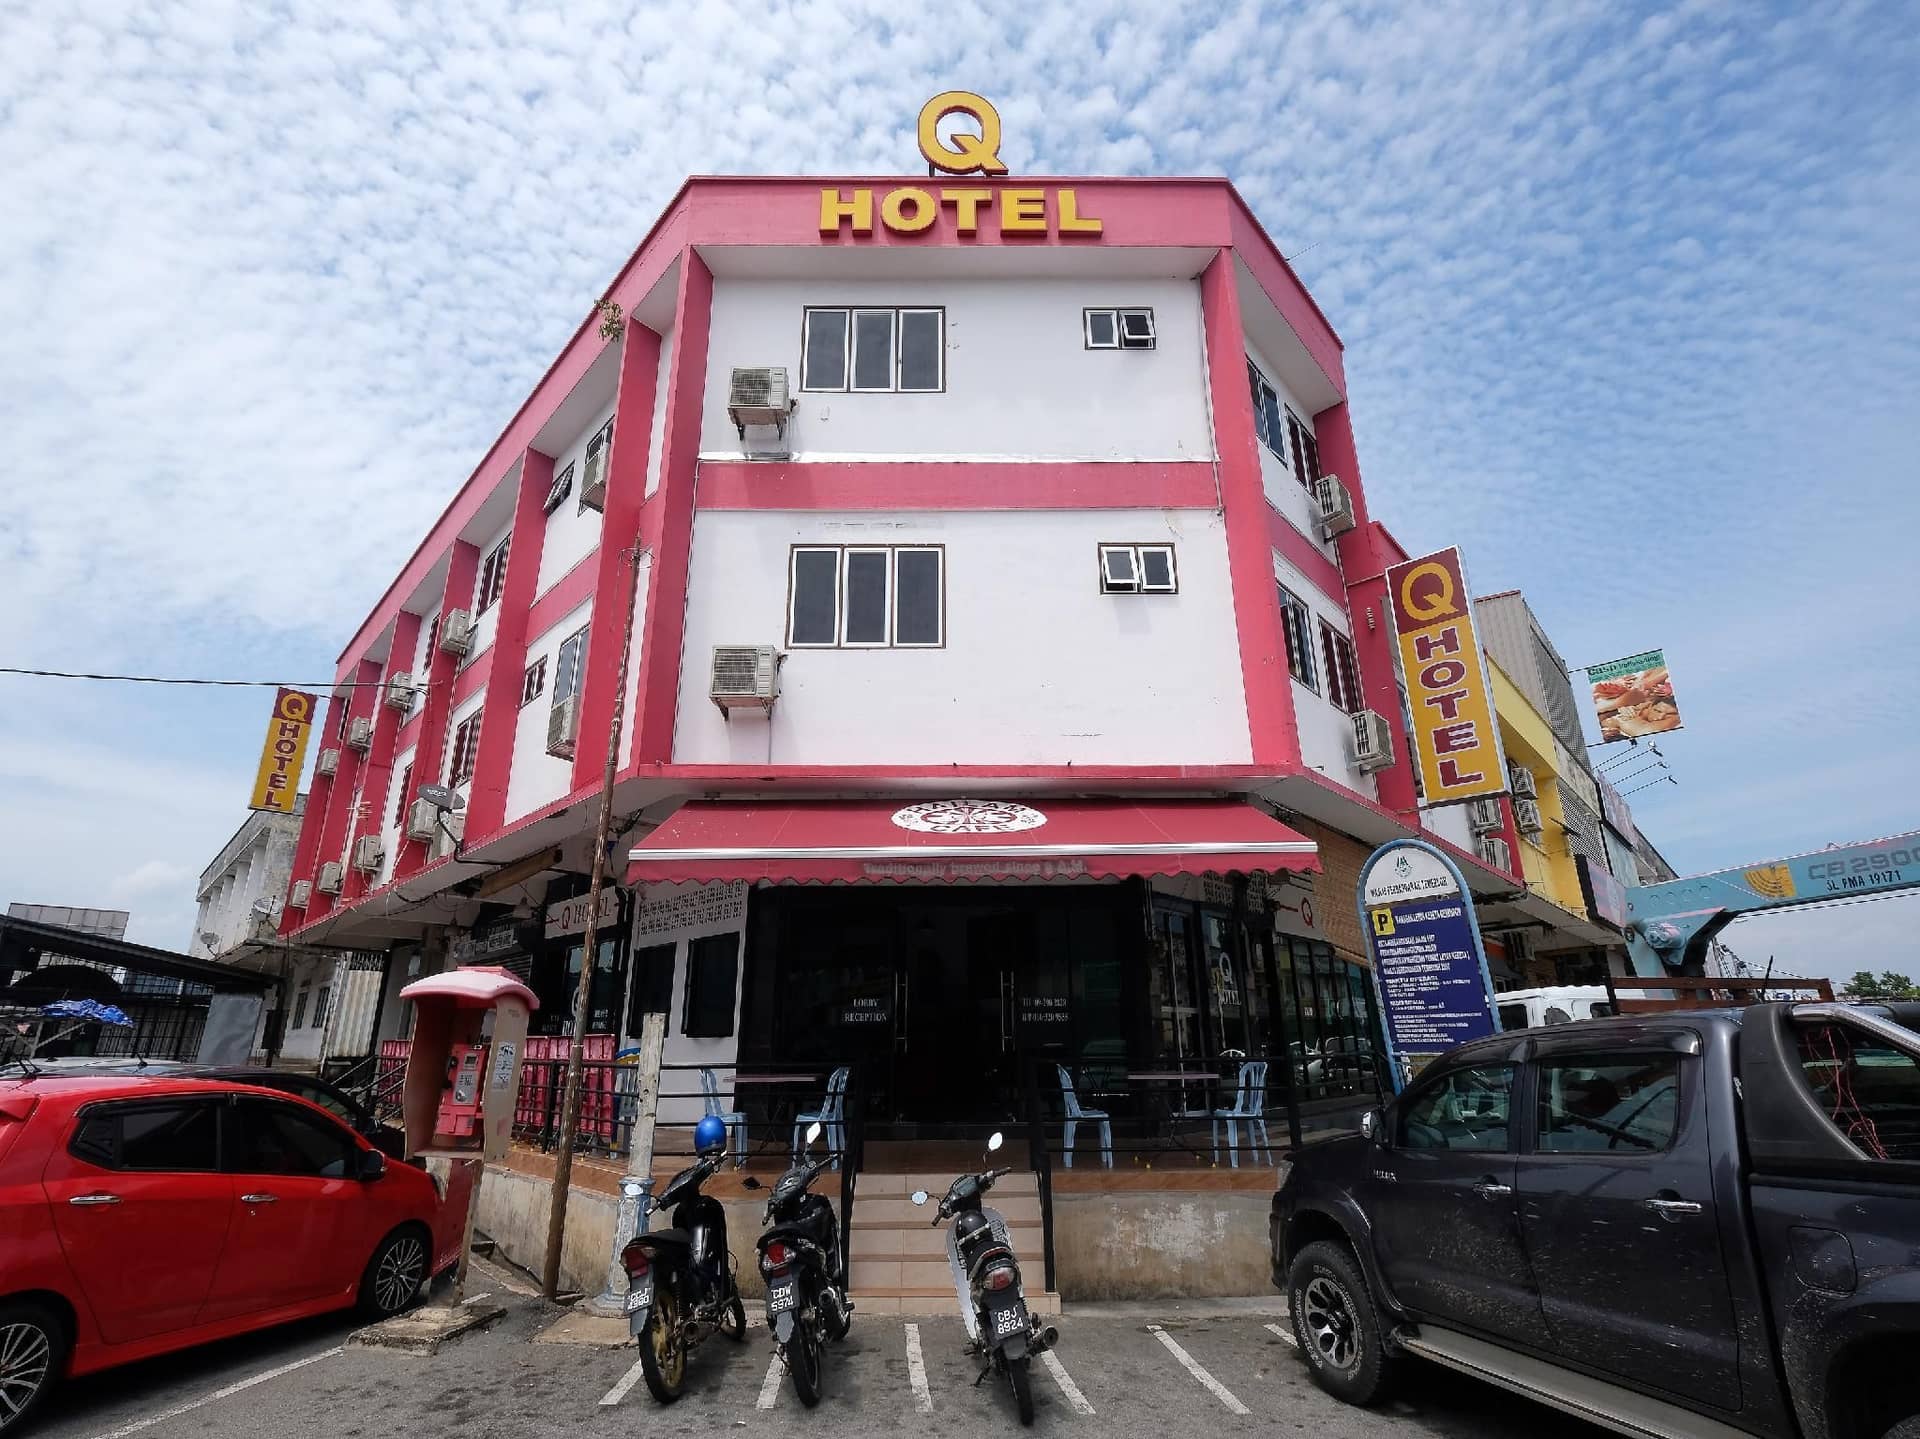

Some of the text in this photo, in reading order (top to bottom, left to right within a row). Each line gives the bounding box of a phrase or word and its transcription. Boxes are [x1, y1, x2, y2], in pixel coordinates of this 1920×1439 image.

[918, 90, 1008, 175] Q
[819, 187, 1103, 237] HOTEL
[1402, 562, 1483, 788] Q HOTEL
[265, 692, 308, 808] Q HOTEL
[1377, 914, 1387, 931] P
[844, 1012, 887, 1022] RECEPTION
[997, 1306, 1018, 1322] CBJ
